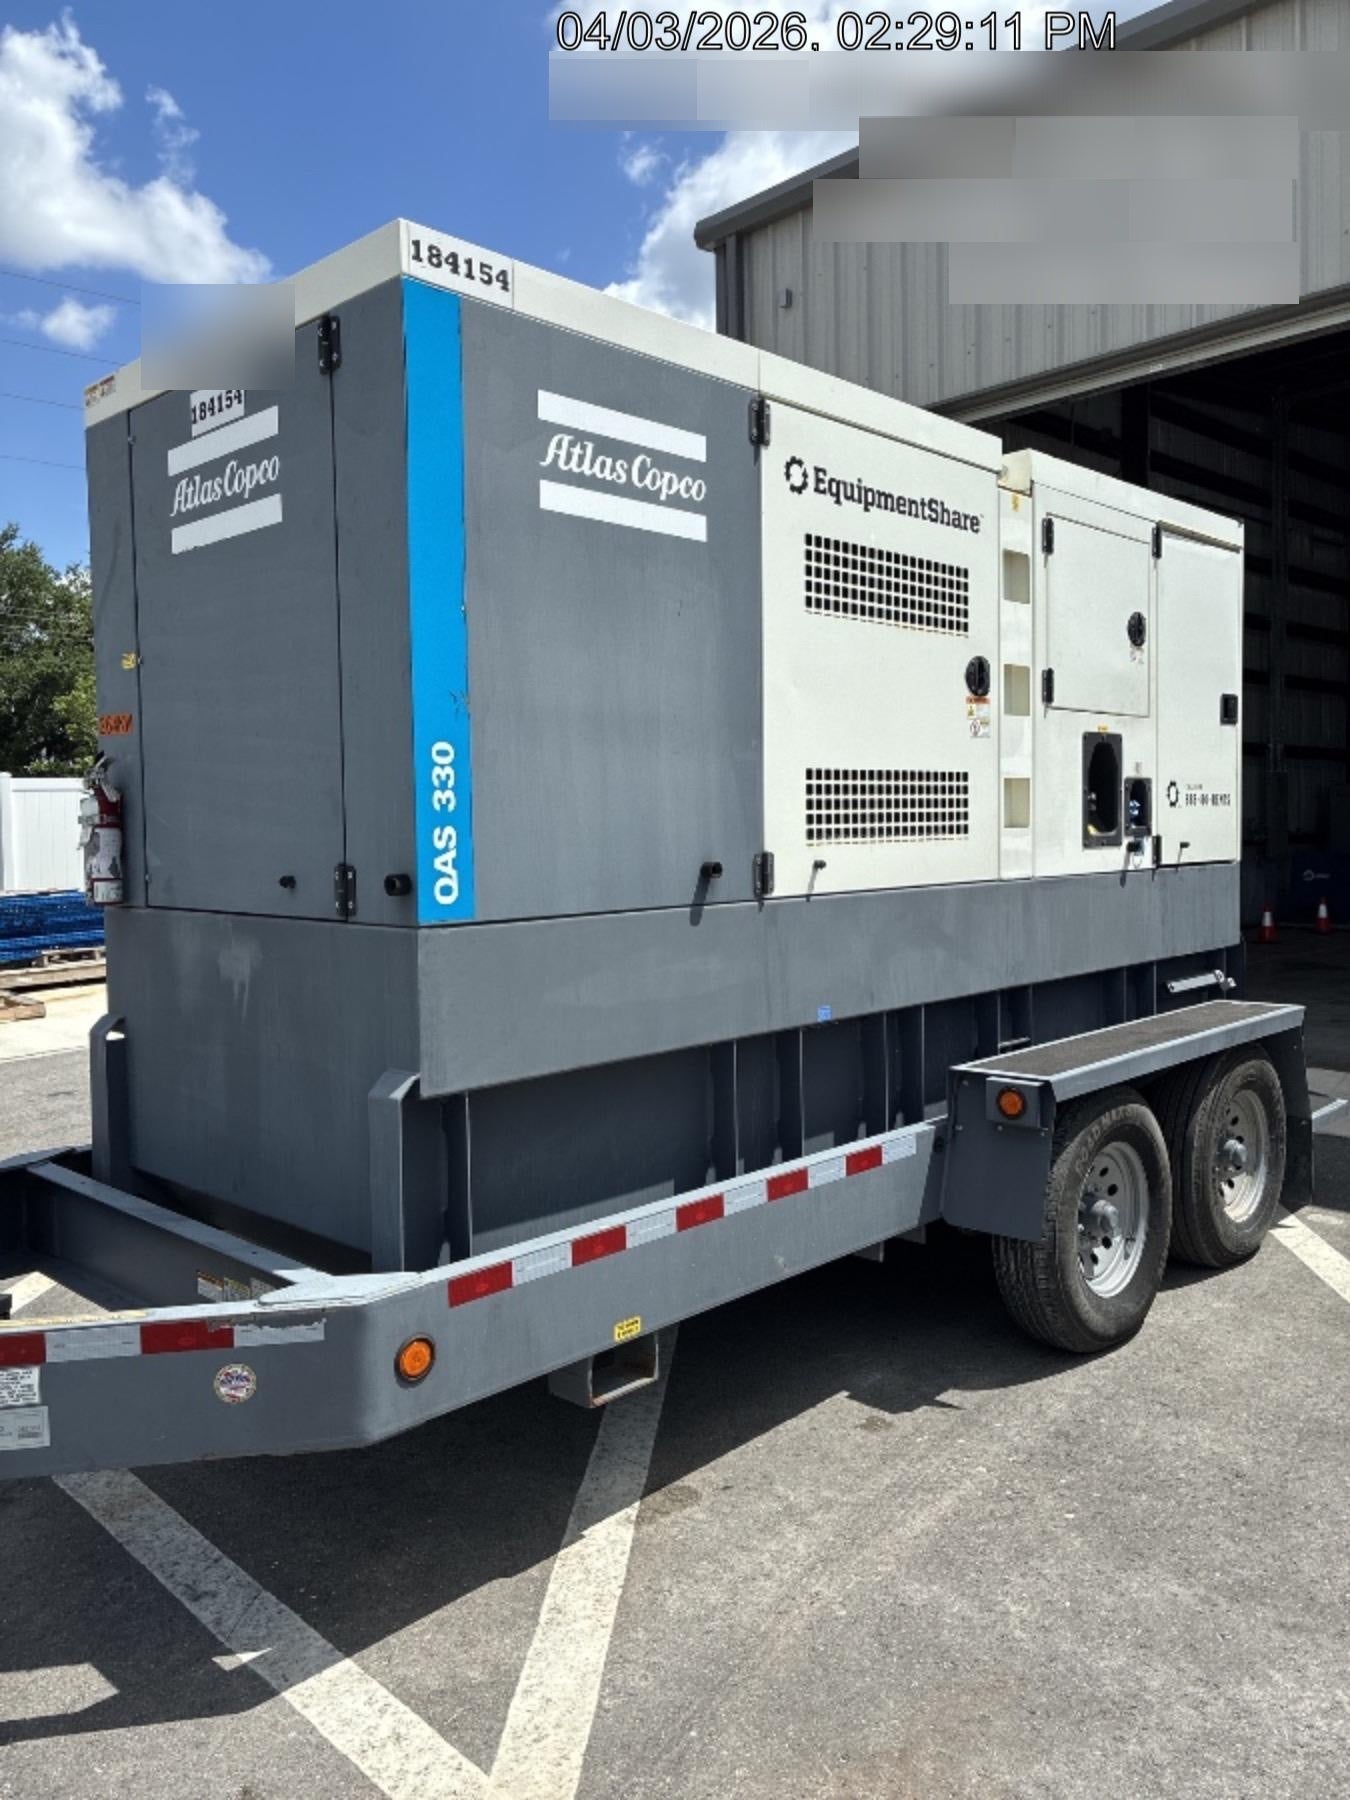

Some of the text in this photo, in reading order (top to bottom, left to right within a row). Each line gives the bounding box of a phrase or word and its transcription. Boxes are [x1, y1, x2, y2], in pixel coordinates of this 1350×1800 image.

[411, 239, 510, 292] 184154
[539, 433, 706, 501] Atlas Copco
[813, 465, 982, 535] EquipmentShare
[431, 741, 459, 906] QAS 330
